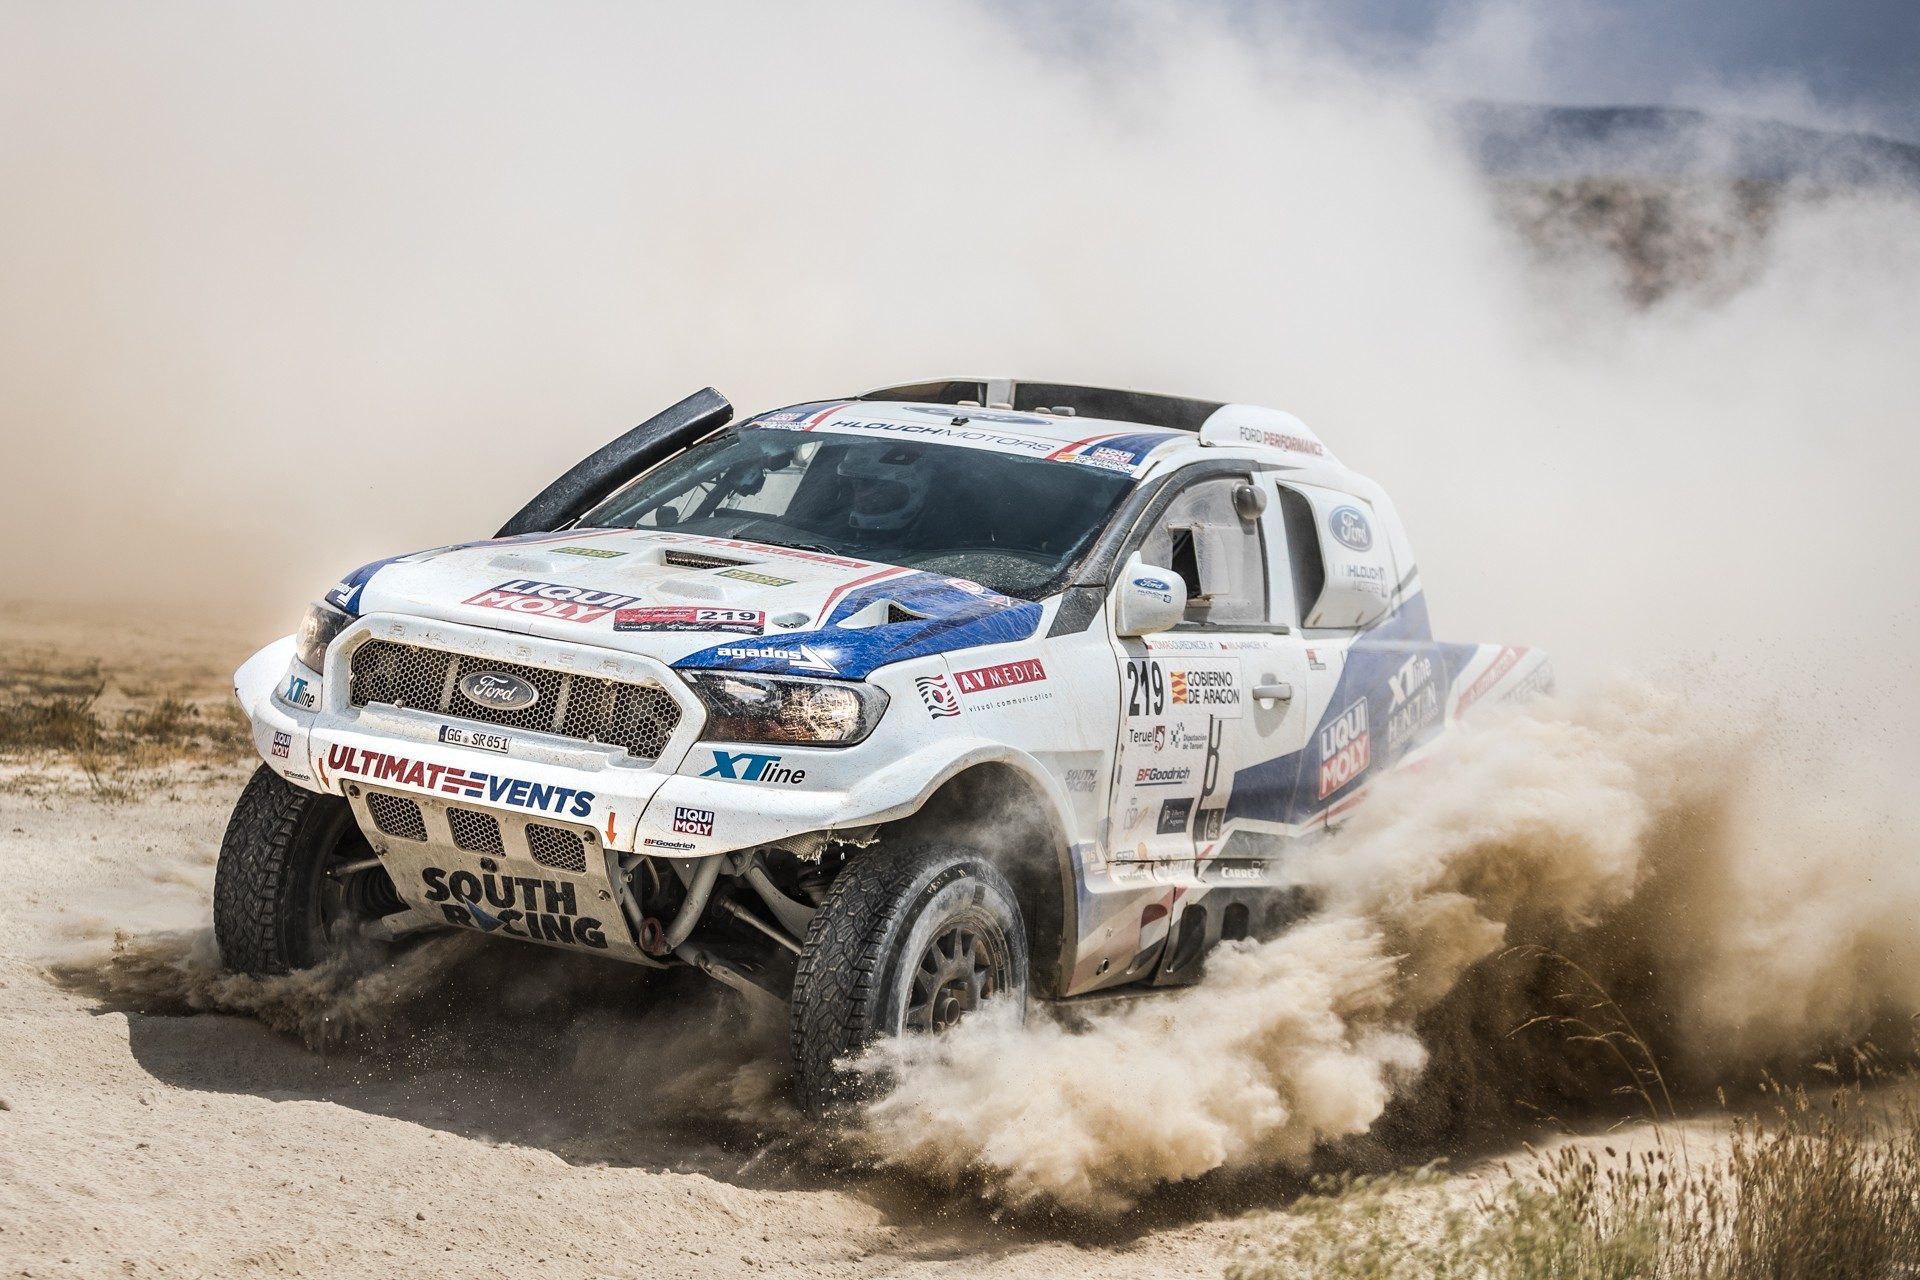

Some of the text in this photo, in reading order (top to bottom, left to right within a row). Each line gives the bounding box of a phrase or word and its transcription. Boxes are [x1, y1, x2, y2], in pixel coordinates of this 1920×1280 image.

[1240, 426, 1324, 456] FORD PERFORMANCE
[1341, 511, 1368, 544] Ford
[1140, 579, 1164, 588] Ford
[499, 581, 633, 609] LIQUI
[474, 591, 607, 619] MOLY
[700, 611, 756, 621] 219
[717, 647, 801, 660] agados
[989, 663, 1043, 686] MEDIA
[1187, 671, 1233, 686] GOBIERNO
[284, 674, 315, 708] XTline
[472, 674, 515, 702] Ford
[1127, 661, 1164, 716] 219
[969, 692, 1053, 712] visual communication
[1188, 689, 1240, 704] DE ARAGON
[275, 732, 291, 745] LIQUI
[447, 729, 462, 742] GG
[1129, 727, 1155, 743] Teruel
[1322, 702, 1367, 761] LIQUI
[272, 743, 289, 757] MOLY
[699, 750, 805, 784] XTline
[1137, 766, 1191, 782] BFGoodrich
[1322, 738, 1368, 794] MOLY
[1066, 769, 1097, 781] SOUTH
[677, 807, 714, 823] LIQUI
[674, 820, 712, 836] MOLY
[644, 838, 696, 849] BFGoodrich
[421, 866, 578, 916] SOUTH
